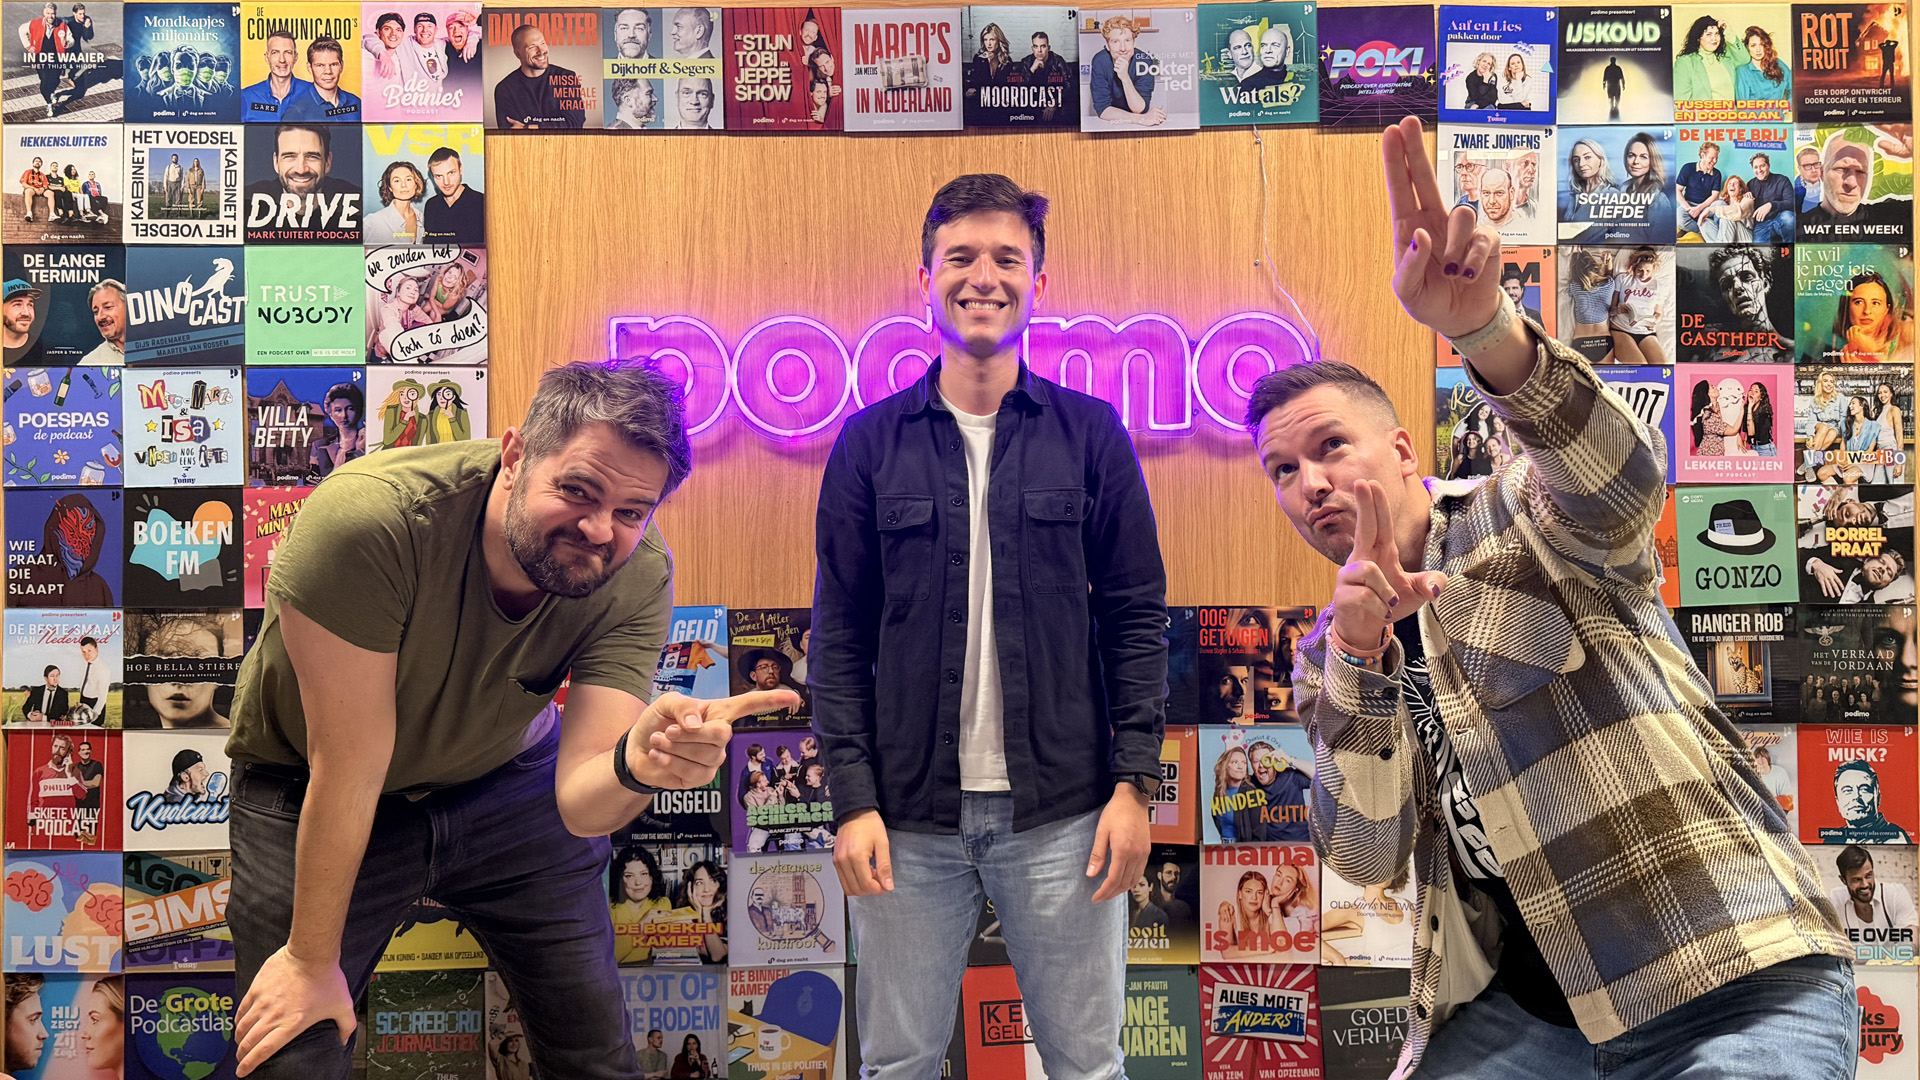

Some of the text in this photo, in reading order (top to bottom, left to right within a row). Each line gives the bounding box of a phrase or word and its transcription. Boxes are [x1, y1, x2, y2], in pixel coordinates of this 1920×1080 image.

[256, 7, 264, 17] DE
[144, 15, 225, 29] Mondkapjes
[152, 29, 219, 42] miljonairs
[1566, 21, 1661, 45] IJSKOUD
[1801, 13, 1852, 48] ROT
[743, 34, 792, 50] STIJN
[23, 53, 104, 63] IN DE WAAIER
[735, 51, 778, 68] TOBI
[1135, 52, 1176, 60] GEZONDER
[1330, 47, 1424, 79] POKI
[1803, 48, 1849, 70] FRUIT
[611, 62, 715, 76] Dijkhoff & Segers
[735, 68, 791, 84] JEPPE
[1135, 62, 1194, 76] Dokter
[550, 75, 582, 86] MISSIE
[383, 86, 463, 109] Bennies
[553, 88, 596, 98] MENTALE
[735, 85, 791, 102] SHOW
[856, 87, 952, 114] IN NEDERLAND
[980, 86, 1064, 108] MOORDCAST
[1219, 86, 1300, 105] Wat als?
[1675, 100, 1790, 109] TUSSEN DERTIG
[20, 136, 108, 147] HEKKENSLUITERS
[132, 131, 238, 145] HET VOEDSEL
[1453, 134, 1541, 149] ZWARE JONGENS
[1679, 130, 1702, 141] DE
[1705, 129, 1746, 141] HETE
[1750, 129, 1788, 141] BRIJ
[1578, 193, 1655, 205] SCHADUW
[247, 193, 361, 229] DRIVE
[1589, 206, 1644, 218] LIEFDE
[248, 231, 360, 239] MARK TUITERT PODCAST
[1804, 224, 1904, 234] WAT EEN WEEK!
[23, 254, 105, 267] DE LANGE
[29, 269, 100, 283] TERMIJN
[1624, 287, 1653, 302] girls
[258, 306, 353, 324] NOBODY
[1681, 314, 1705, 329] DE
[1680, 331, 1787, 350] GASTHEER
[609, 303, 1315, 437] podmo
[18, 412, 109, 428] POESPAS
[258, 406, 309, 426] VILLA
[34, 429, 95, 444] de podcast
[254, 427, 313, 448] BETTY
[1685, 460, 1732, 470] LEKKER
[173, 476, 196, 485] Tonny
[133, 521, 233, 545] BOEKEN
[1825, 527, 1886, 542] BORREL
[9, 541, 36, 551] WIE
[166, 551, 200, 575] FM
[9, 569, 31, 579] DIE
[1695, 564, 1782, 590] GONZO
[9, 584, 64, 595] SLAAPT
[736, 612, 749, 624] De
[766, 612, 789, 624] Aller
[1200, 609, 1227, 627] OOG
[1691, 612, 1784, 634] RANGER ROB
[672, 619, 719, 643] GELD
[729, 621, 762, 637] Nummer
[1200, 628, 1269, 647] GETUIGEN
[1832, 650, 1895, 659] VERRAAD
[1245, 712, 1270, 720] podimo
[1844, 710, 1870, 718] podimo
[1828, 747, 1888, 762] MUSK?
[654, 791, 722, 815] LOSGELD
[34, 808, 100, 820] SKIETE WILLY
[36, 820, 98, 836] PODCAST
[1204, 845, 1314, 867] mama
[749, 860, 823, 874] de vlaamse
[1330, 901, 1350, 910] OLD
[615, 923, 723, 935] DE BOEKEN
[1129, 923, 1166, 938] ooit
[1863, 928, 1914, 942] OVER
[632, 935, 704, 948] KAMER
[1205, 923, 1316, 952] is moe
[11, 935, 118, 966] LUST
[396, 953, 415, 962] KONING
[421, 952, 442, 961] SANDER
[444, 952, 454, 960] VAN
[730, 969, 790, 983] DE BINNEN
[1144, 981, 1168, 990] PFAUTH
[130, 993, 233, 1014] De Grote
[1219, 989, 1303, 1010] ALLES MOET
[51, 1021, 80, 1030] ZEGT
[131, 1012, 234, 1035] Podcastlas
[376, 1011, 482, 1034] SCOREBORD
[651, 1005, 720, 1032] BODEM
[1224, 1009, 1293, 1032] ANDERS
[377, 1034, 480, 1053] JOURNALISTIEK
[1122, 1026, 1187, 1057] JAREN
[1860, 1028, 1903, 1052] jury
[747, 1060, 828, 1071] THUIS IN DE POLITIEK
[1259, 1068, 1320, 1078] VAN OPZEELAND
[1208, 1070, 1244, 1080] VAN ZELM
